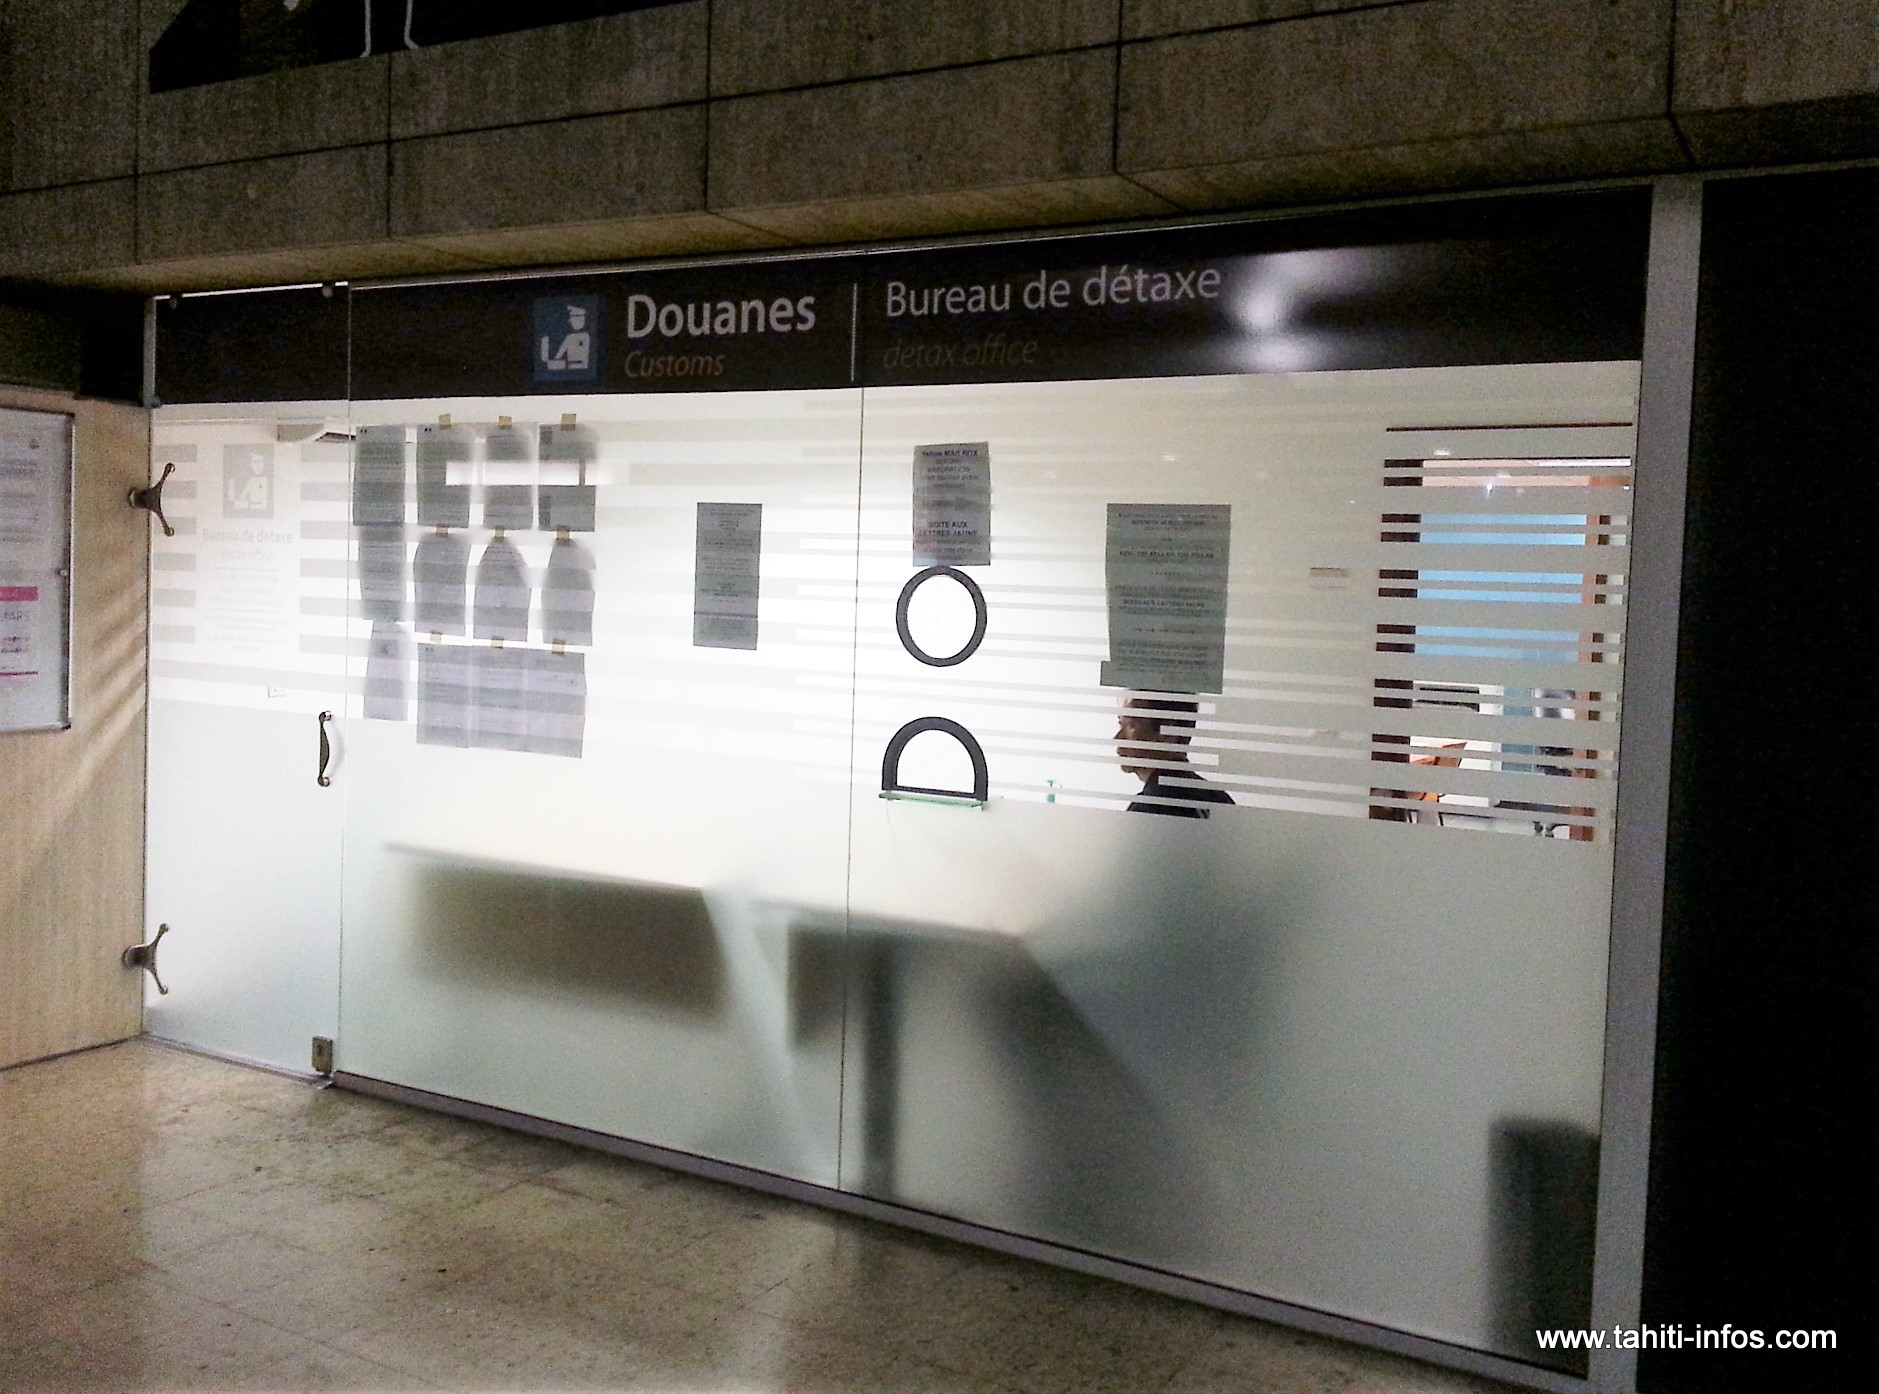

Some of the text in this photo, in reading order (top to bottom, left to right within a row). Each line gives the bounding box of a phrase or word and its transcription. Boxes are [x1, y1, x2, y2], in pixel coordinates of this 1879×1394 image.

[886, 264, 1221, 318] Bureau de détaxe
[627, 294, 816, 338] Douanes
[624, 350, 726, 378] Customs
[884, 333, 1038, 370] detax office
[203, 528, 240, 542] Bureau
[240, 529, 255, 543] de
